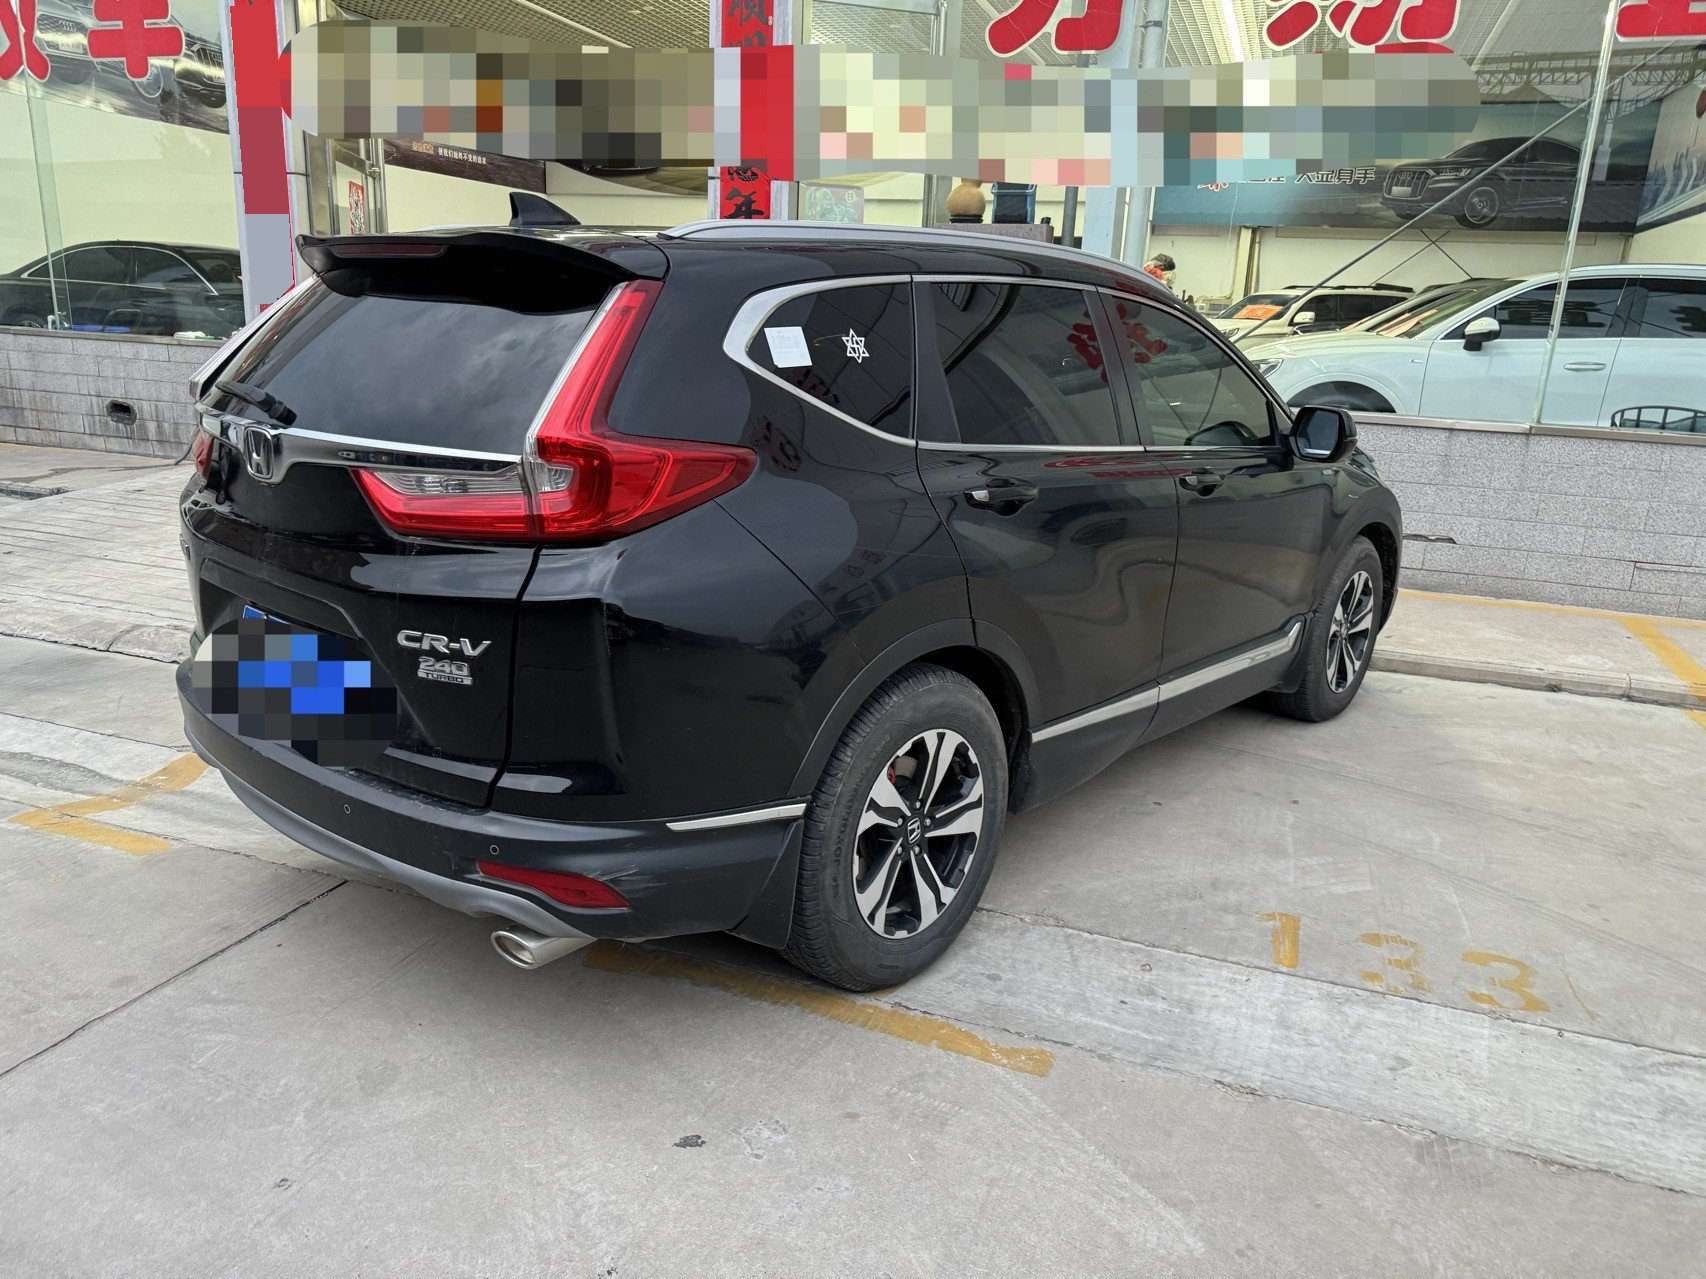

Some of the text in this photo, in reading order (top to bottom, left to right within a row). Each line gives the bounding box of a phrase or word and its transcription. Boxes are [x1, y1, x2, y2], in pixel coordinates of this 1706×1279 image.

[396, 629, 492, 657] CR-V
[418, 655, 470, 677] 240
[424, 671, 465, 684] TURBO
